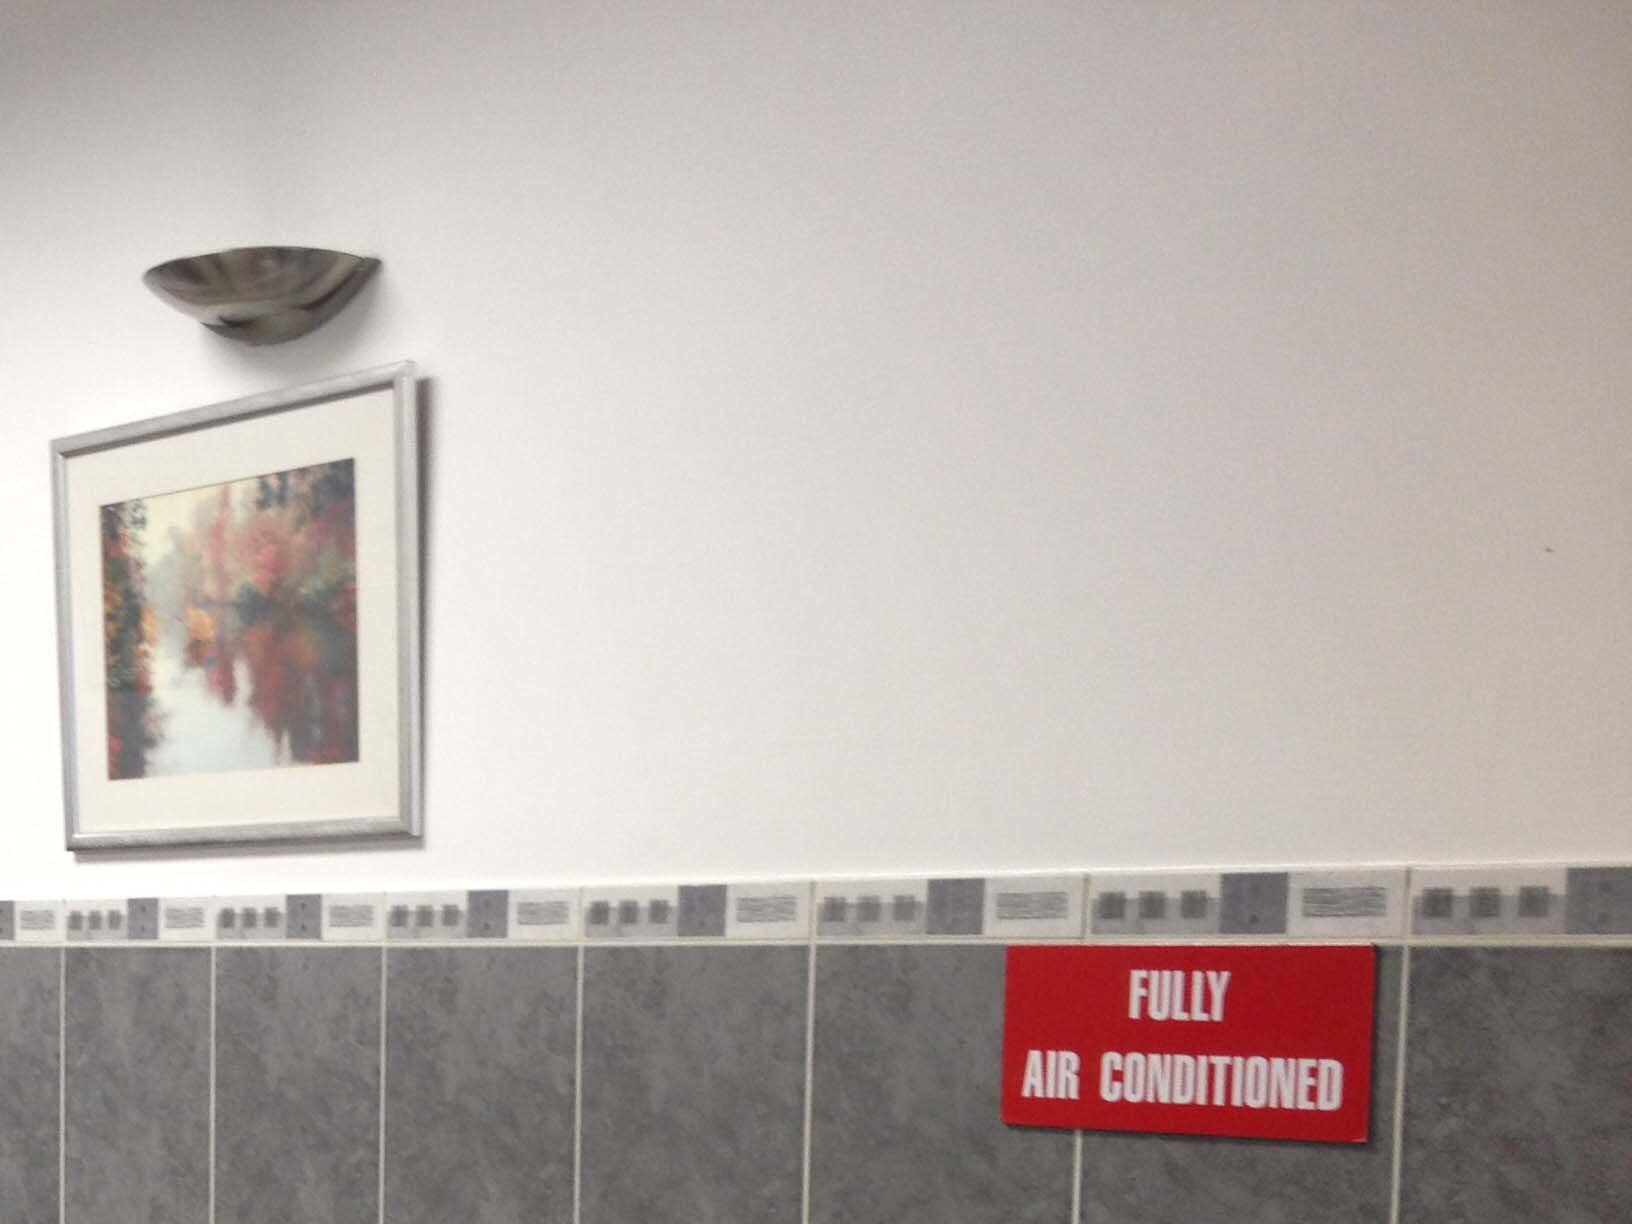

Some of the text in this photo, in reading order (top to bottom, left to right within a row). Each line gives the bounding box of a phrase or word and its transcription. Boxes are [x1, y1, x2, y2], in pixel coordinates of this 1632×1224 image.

[1128, 969, 1232, 1022] FULLY
[1021, 1049, 1344, 1111] AIR CONDITIONED
